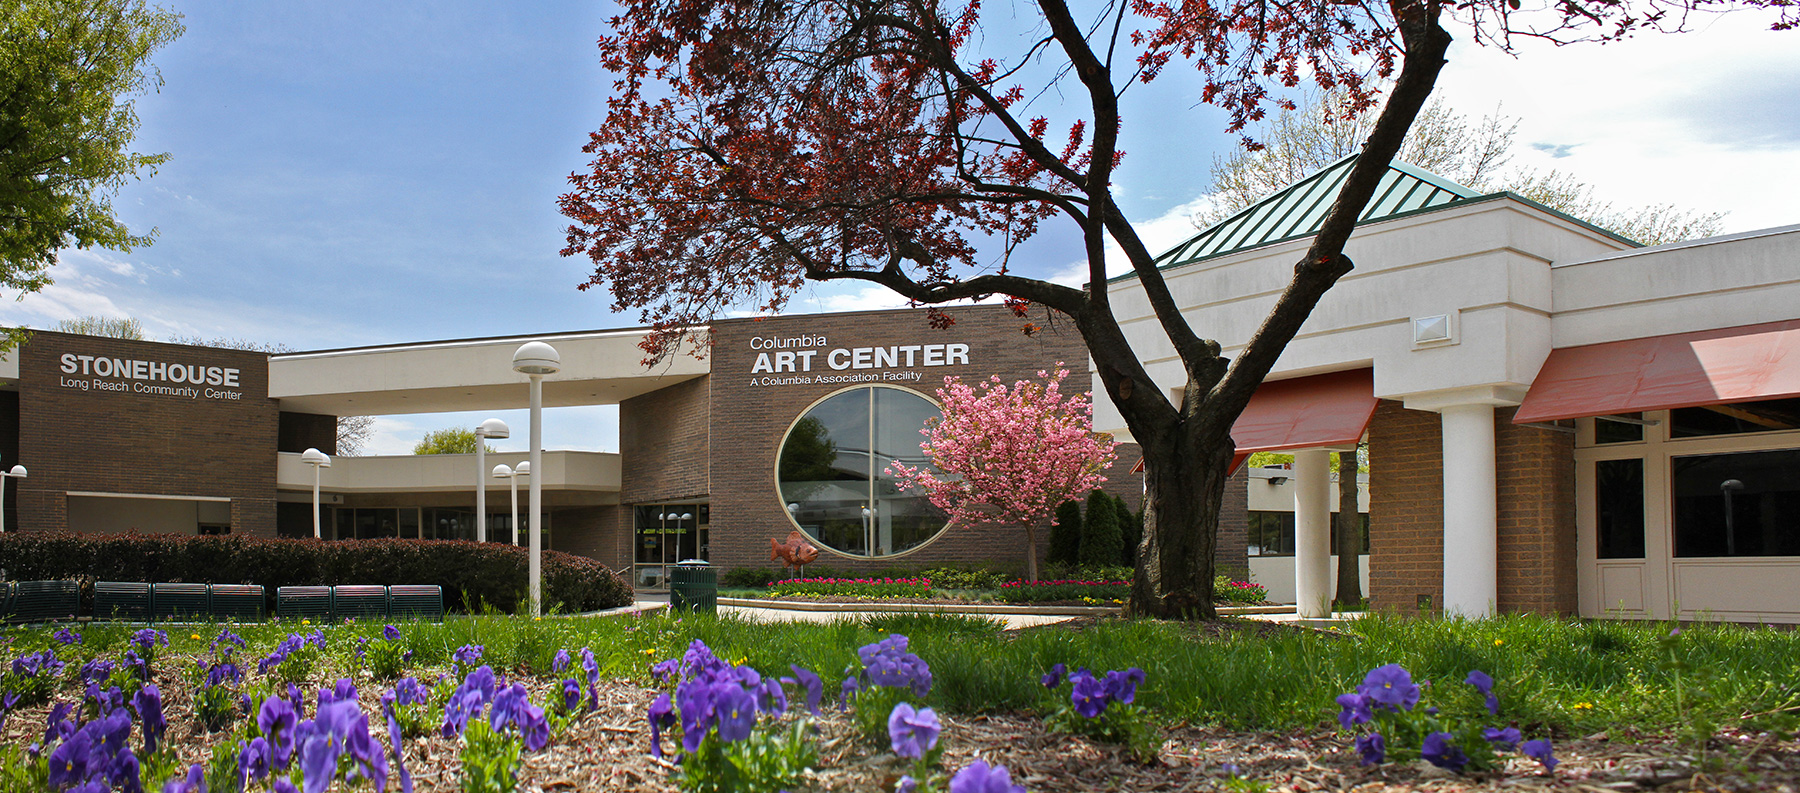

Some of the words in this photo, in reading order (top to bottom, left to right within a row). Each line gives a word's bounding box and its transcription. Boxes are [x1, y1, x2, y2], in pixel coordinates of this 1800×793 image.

[750, 334, 827, 350] Columbia
[60, 353, 240, 387] STONEHOUSE
[751, 350, 817, 374] ART
[827, 343, 970, 370] CENTER
[60, 376, 89, 391] Long
[93, 379, 129, 392] Reach
[133, 382, 199, 399] Community
[204, 388, 242, 400] Center
[750, 378, 758, 386] A
[761, 375, 811, 387] Columbia
[814, 372, 879, 385] Association
[883, 371, 922, 382] Facility
